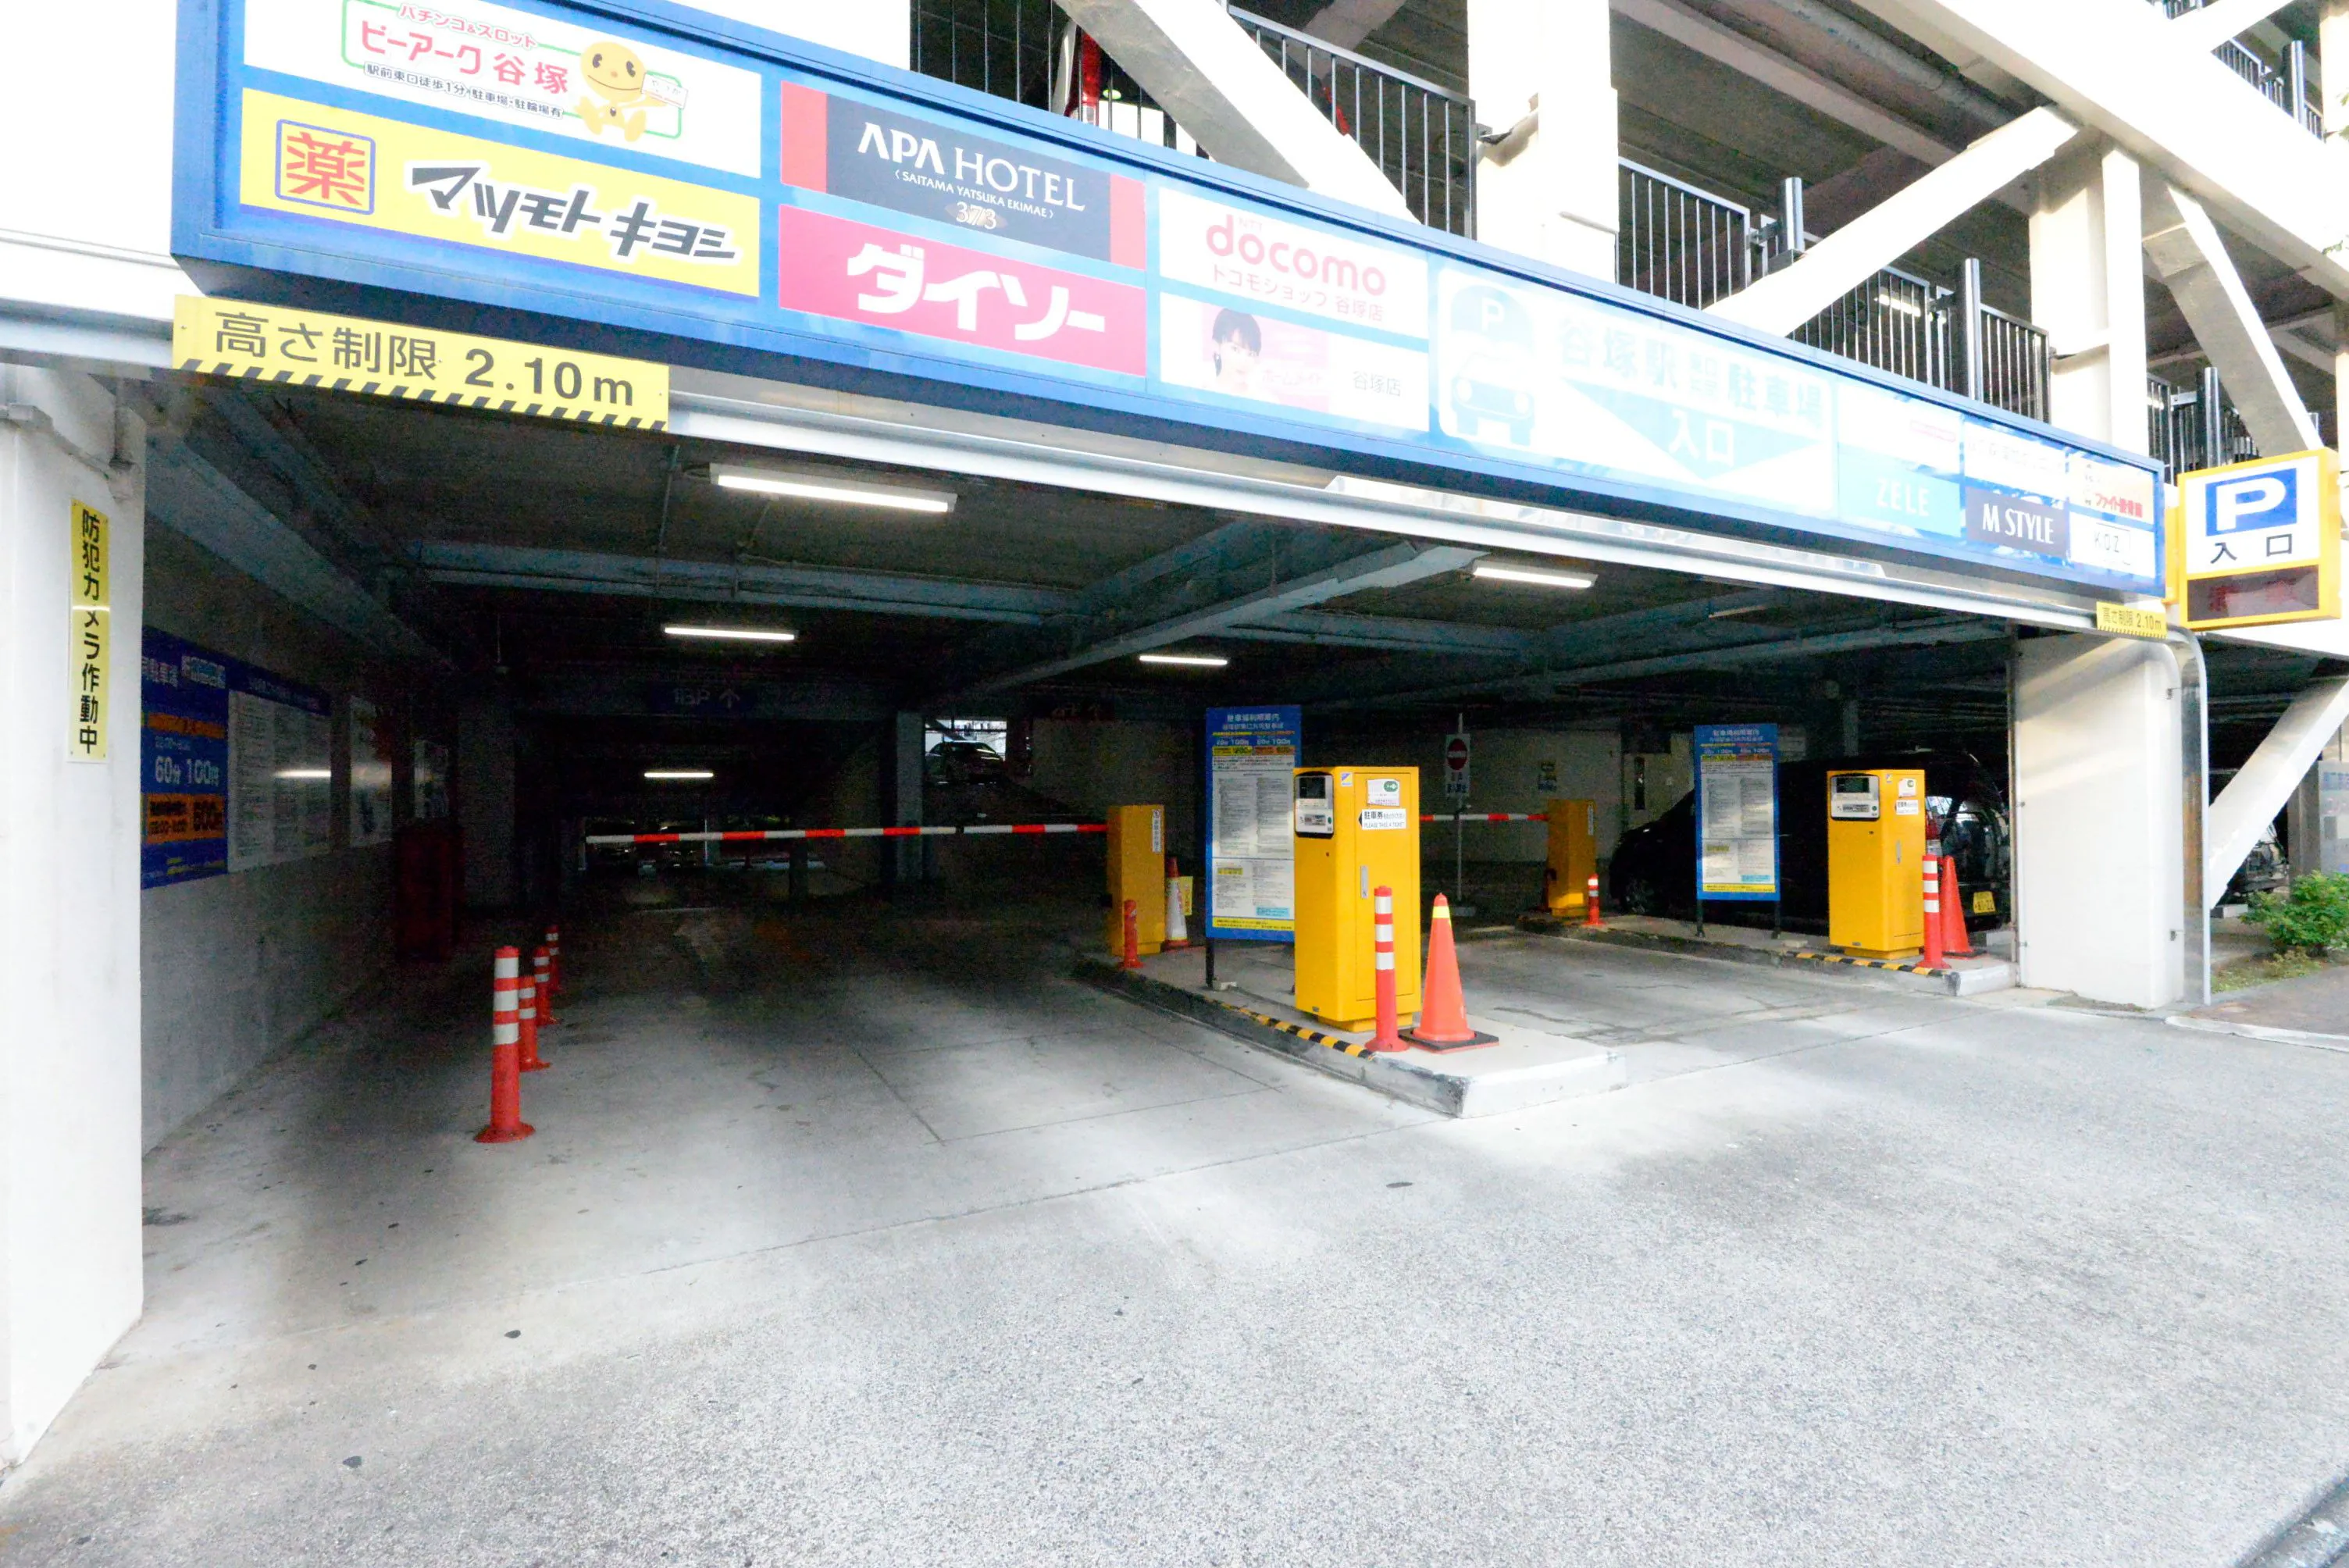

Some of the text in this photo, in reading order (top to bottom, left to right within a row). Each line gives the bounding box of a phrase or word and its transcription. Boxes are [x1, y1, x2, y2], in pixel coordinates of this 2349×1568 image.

[362, 20, 569, 94] ピーアーク 谷塚
[286, 131, 367, 206] 薬
[857, 122, 1085, 212] APA HOTEL
[957, 185, 1004, 207] YATSUKA
[411, 166, 736, 259] マツモトキヨシ
[1206, 215, 1386, 296] docomo
[847, 244, 1106, 341] ダイソー
[1335, 297, 1385, 323] 谷塚店
[1481, 298, 1504, 331] P
[215, 312, 633, 406] 高さ制限 2.10m
[1353, 371, 1403, 398] 谷塚店
[1668, 411, 1735, 469] 入口
[1877, 478, 1930, 517] ZELE
[1982, 504, 2055, 545] M STYLE
[2215, 477, 2287, 532] P
[2210, 533, 2293, 565] 入口
[79, 508, 101, 755] 防犯カメラ作動中
